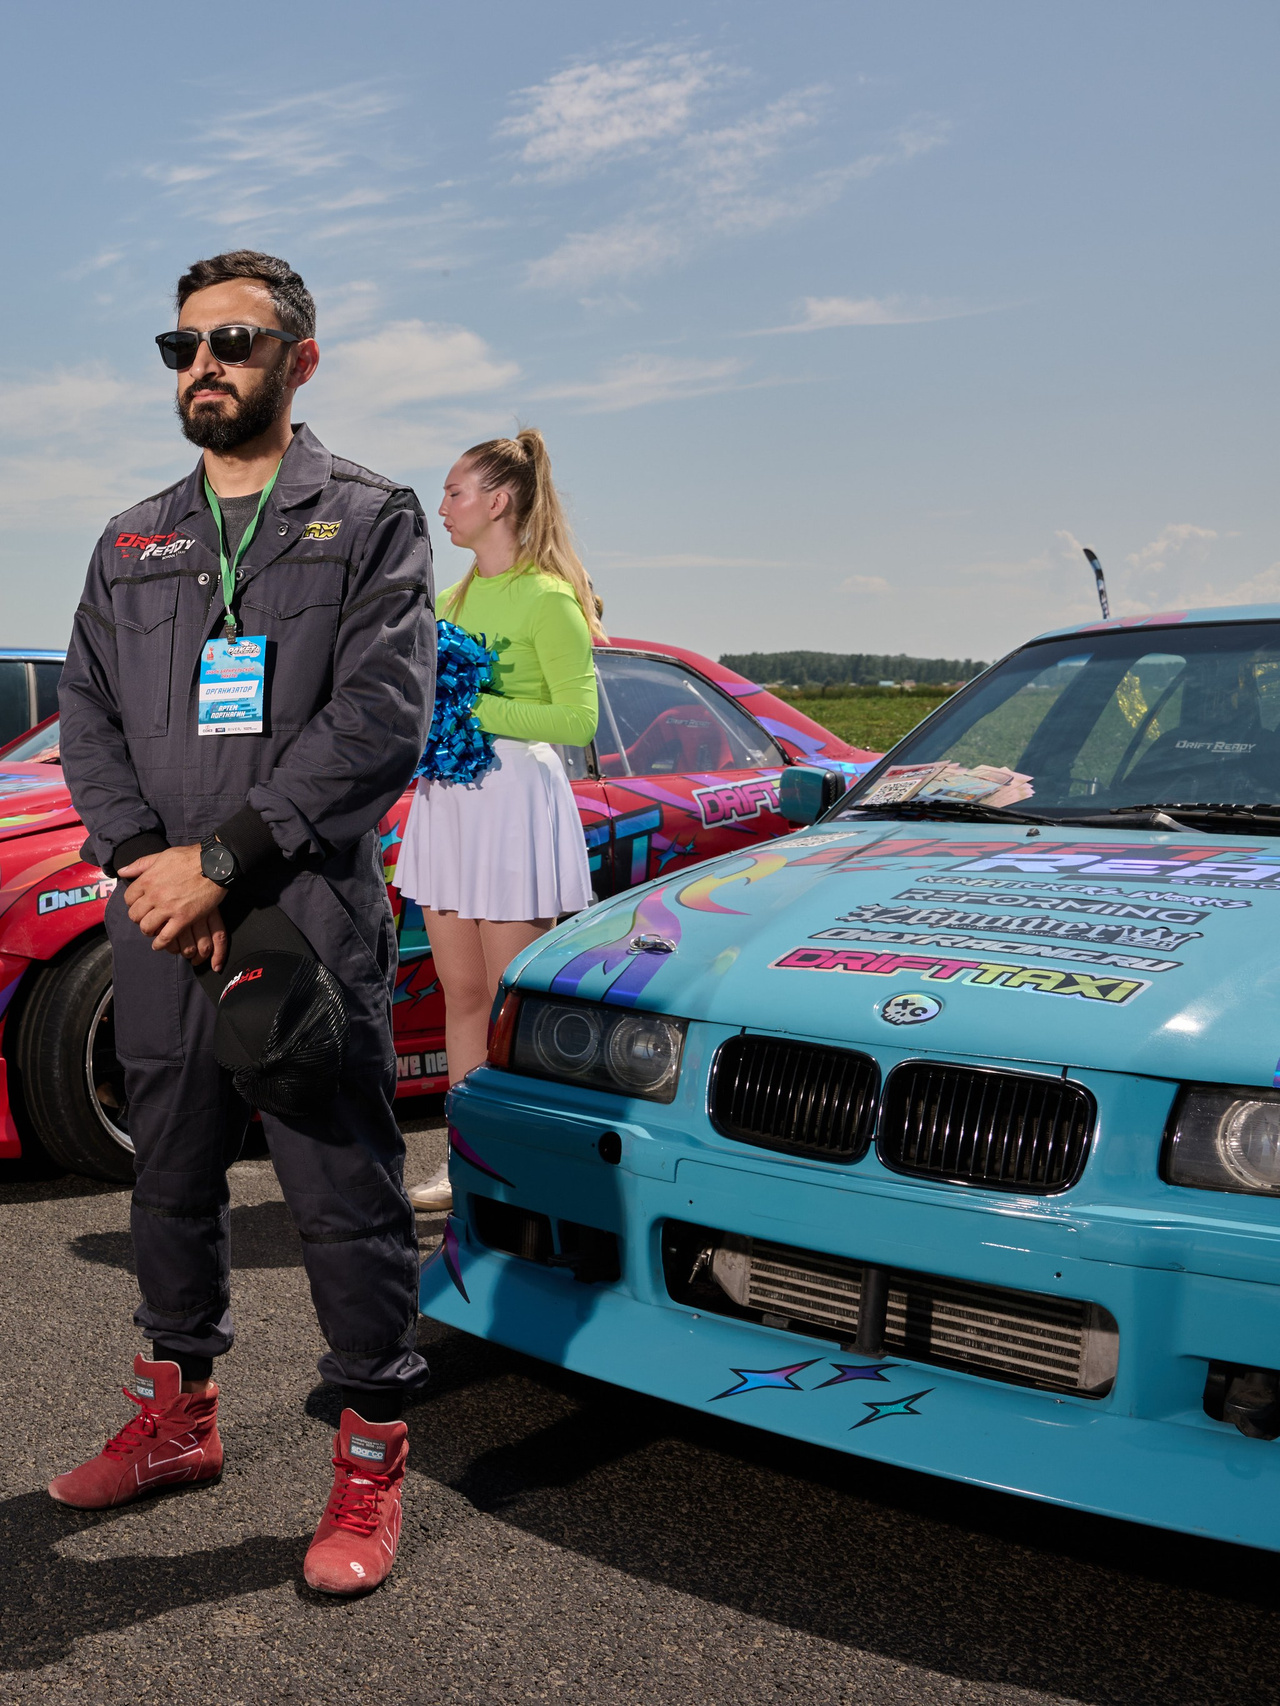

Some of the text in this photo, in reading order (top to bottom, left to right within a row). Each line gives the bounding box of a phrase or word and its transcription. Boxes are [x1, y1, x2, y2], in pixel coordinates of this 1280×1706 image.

[303, 521, 341, 539] AXI
[114, 532, 176, 549] DRIFT
[140, 539, 196, 560] READY
[206, 686, 253, 695] ОРГАНИЗАТОР
[1175, 740, 1257, 751] DRIFT READY
[949, 853, 1280, 881] REA
[1169, 878, 1280, 890] SCHOO
[39, 878, 117, 914] ONLYR
[424, 1051, 448, 1074] ne
